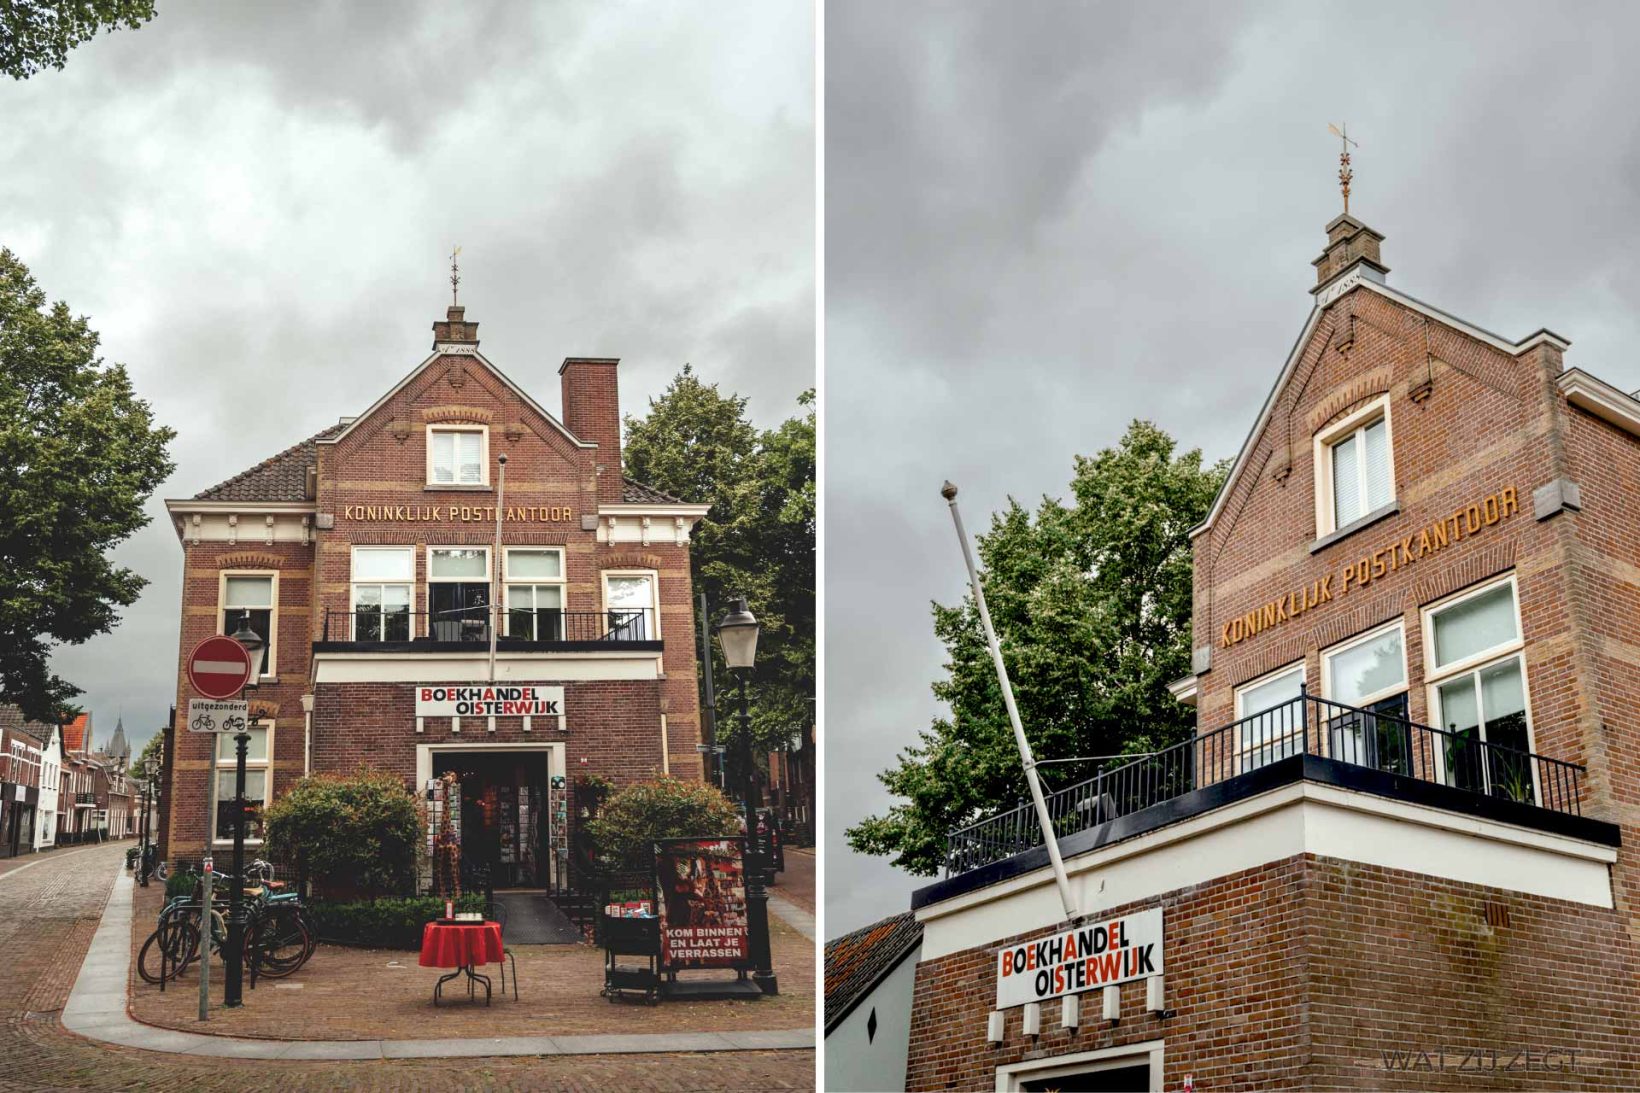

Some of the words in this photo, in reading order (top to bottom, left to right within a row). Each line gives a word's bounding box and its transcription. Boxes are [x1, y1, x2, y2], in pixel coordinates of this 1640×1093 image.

[345, 506, 441, 521] KONINKLIJK
[1221, 574, 1333, 648] KONINKLIJK
[1342, 485, 1519, 593] POSTKANTOOR
[421, 688, 539, 701] BOEKHANDEL
[192, 702, 247, 712] uitgezonderd
[456, 701, 558, 715] OISTERWIJK
[666, 929, 693, 938] KOM
[696, 928, 742, 937] BINNEN
[670, 939, 686, 948] EN
[690, 939, 721, 948] LAAT
[724, 938, 739, 947] JE
[1002, 921, 1130, 977] BOEKHANDEL
[670, 948, 742, 958] VERRASSEN
[1035, 943, 1155, 997] OISTERWIJK
